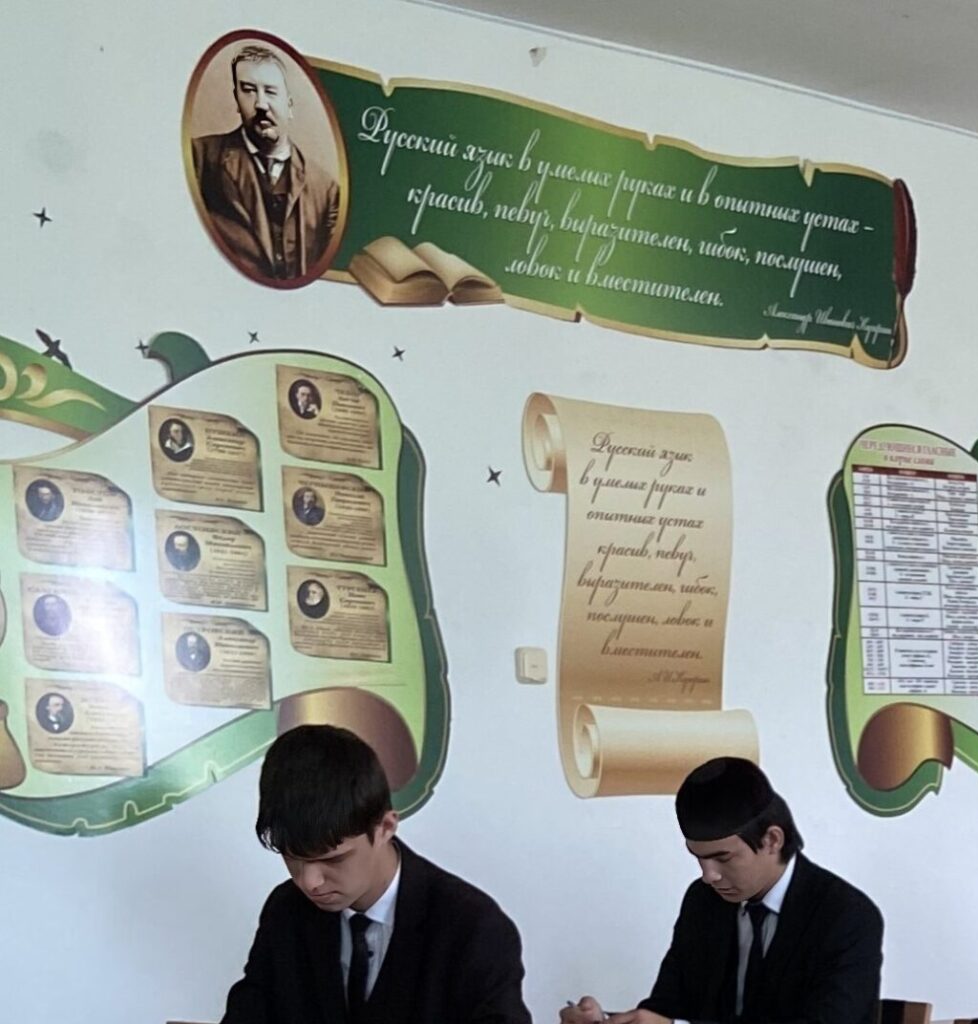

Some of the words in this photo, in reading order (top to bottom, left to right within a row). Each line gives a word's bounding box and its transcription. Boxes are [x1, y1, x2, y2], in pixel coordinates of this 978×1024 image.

[357, 106, 457, 175] Русский
[518, 128, 541, 171] в
[607, 169, 676, 220] руках
[680, 187, 694, 204] и
[697, 165, 718, 205] в
[801, 210, 860, 253] устах
[407, 171, 489, 234] красив,
[755, 249, 842, 298] послушен,
[504, 235, 562, 280] ловок
[567, 268, 580, 283] и
[585, 246, 723, 307] вместителен.
[590, 432, 656, 471] Русский
[580, 459, 596, 485] в
[643, 479, 694, 510] руках
[697, 487, 707, 497] и
[658, 517, 704, 543] устах
[703, 618, 714, 628] и
